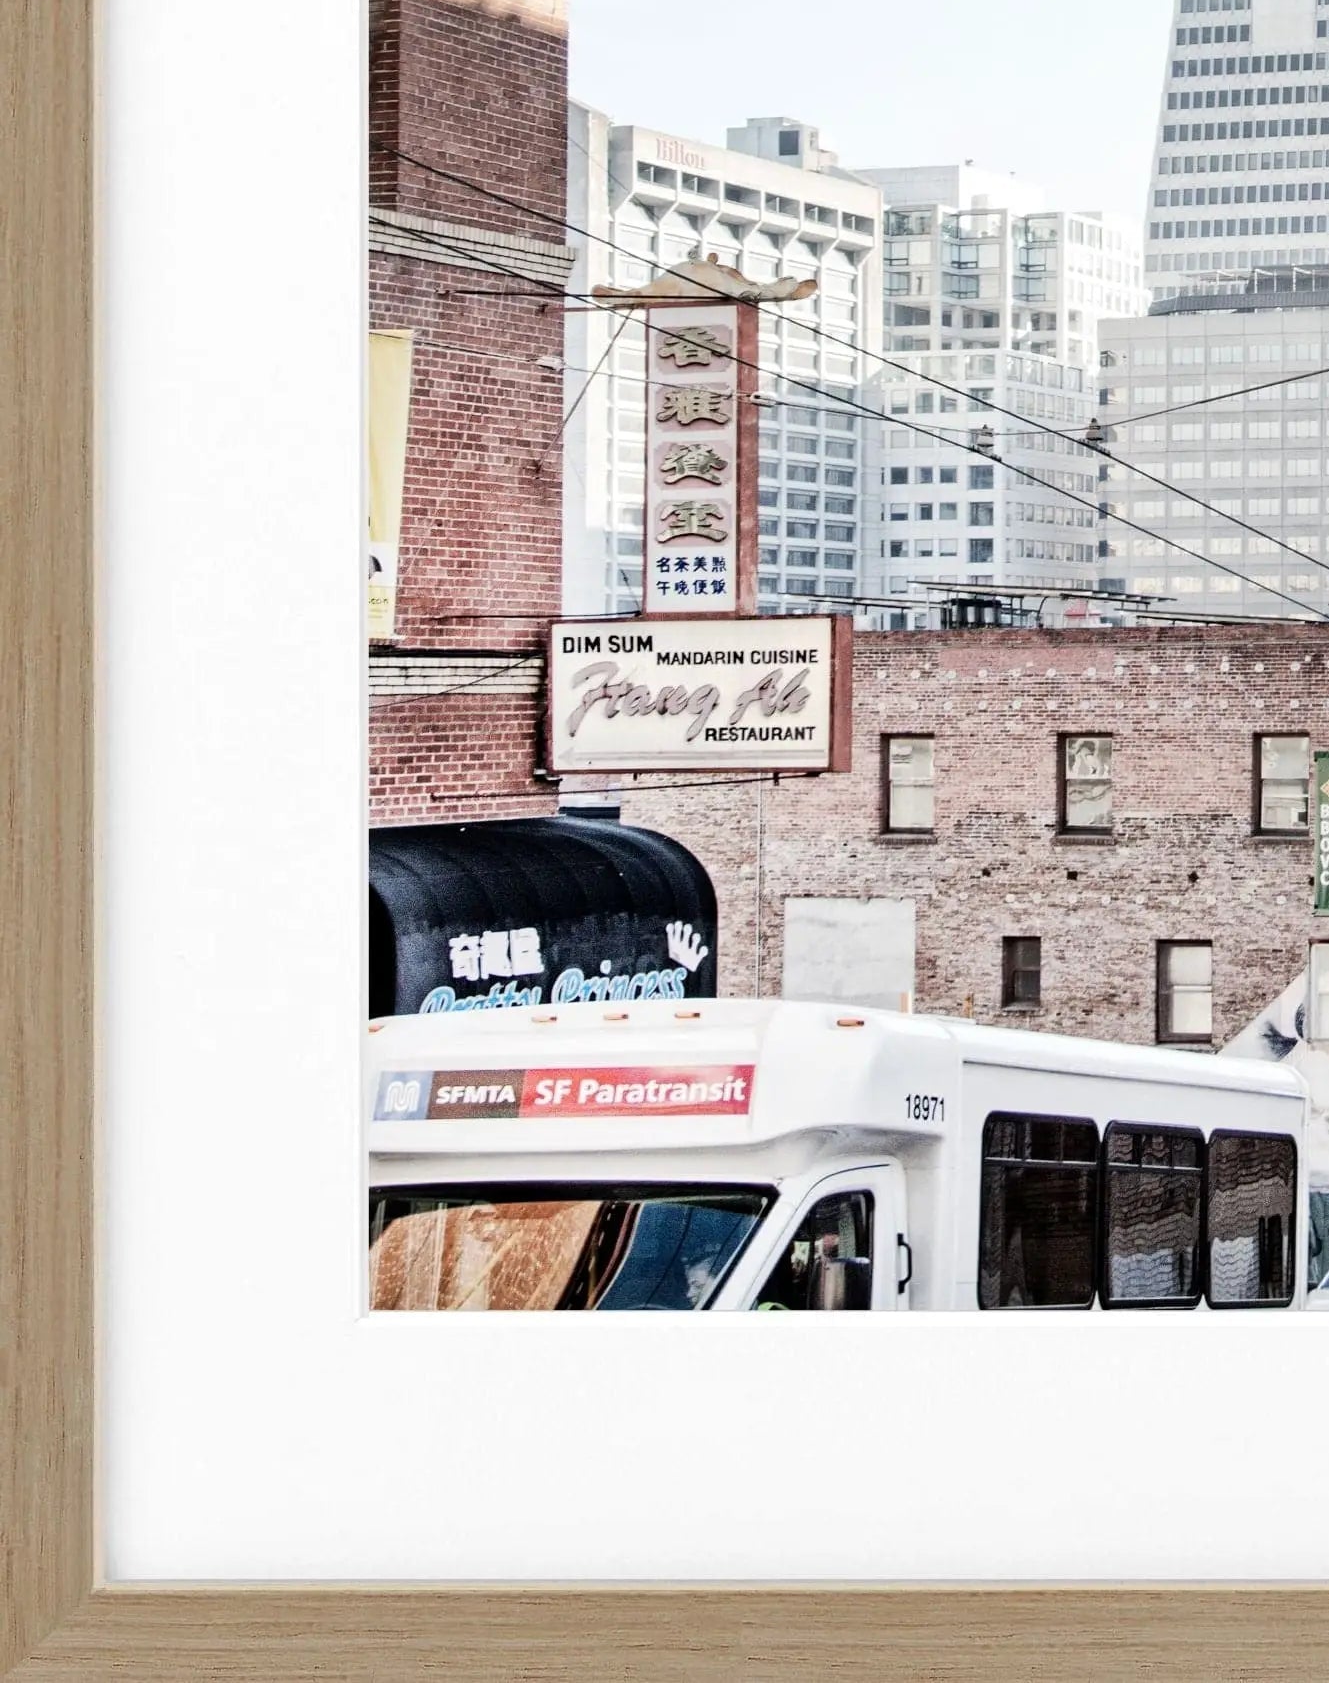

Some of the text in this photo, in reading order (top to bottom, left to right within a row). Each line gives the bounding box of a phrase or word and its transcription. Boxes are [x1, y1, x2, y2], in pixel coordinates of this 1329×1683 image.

[562, 635, 653, 654] DIM SUM
[656, 649, 819, 666] MANDARIN CUISINE
[566, 660, 812, 742] Hang Ah
[704, 725, 816, 742] RESTAURANT
[552, 960, 688, 1004] Princess
[435, 1084, 517, 1105] SFMTA
[534, 1079, 571, 1105] SF
[579, 1076, 746, 1105] Paratransit
[905, 1093, 945, 1122] 18971
